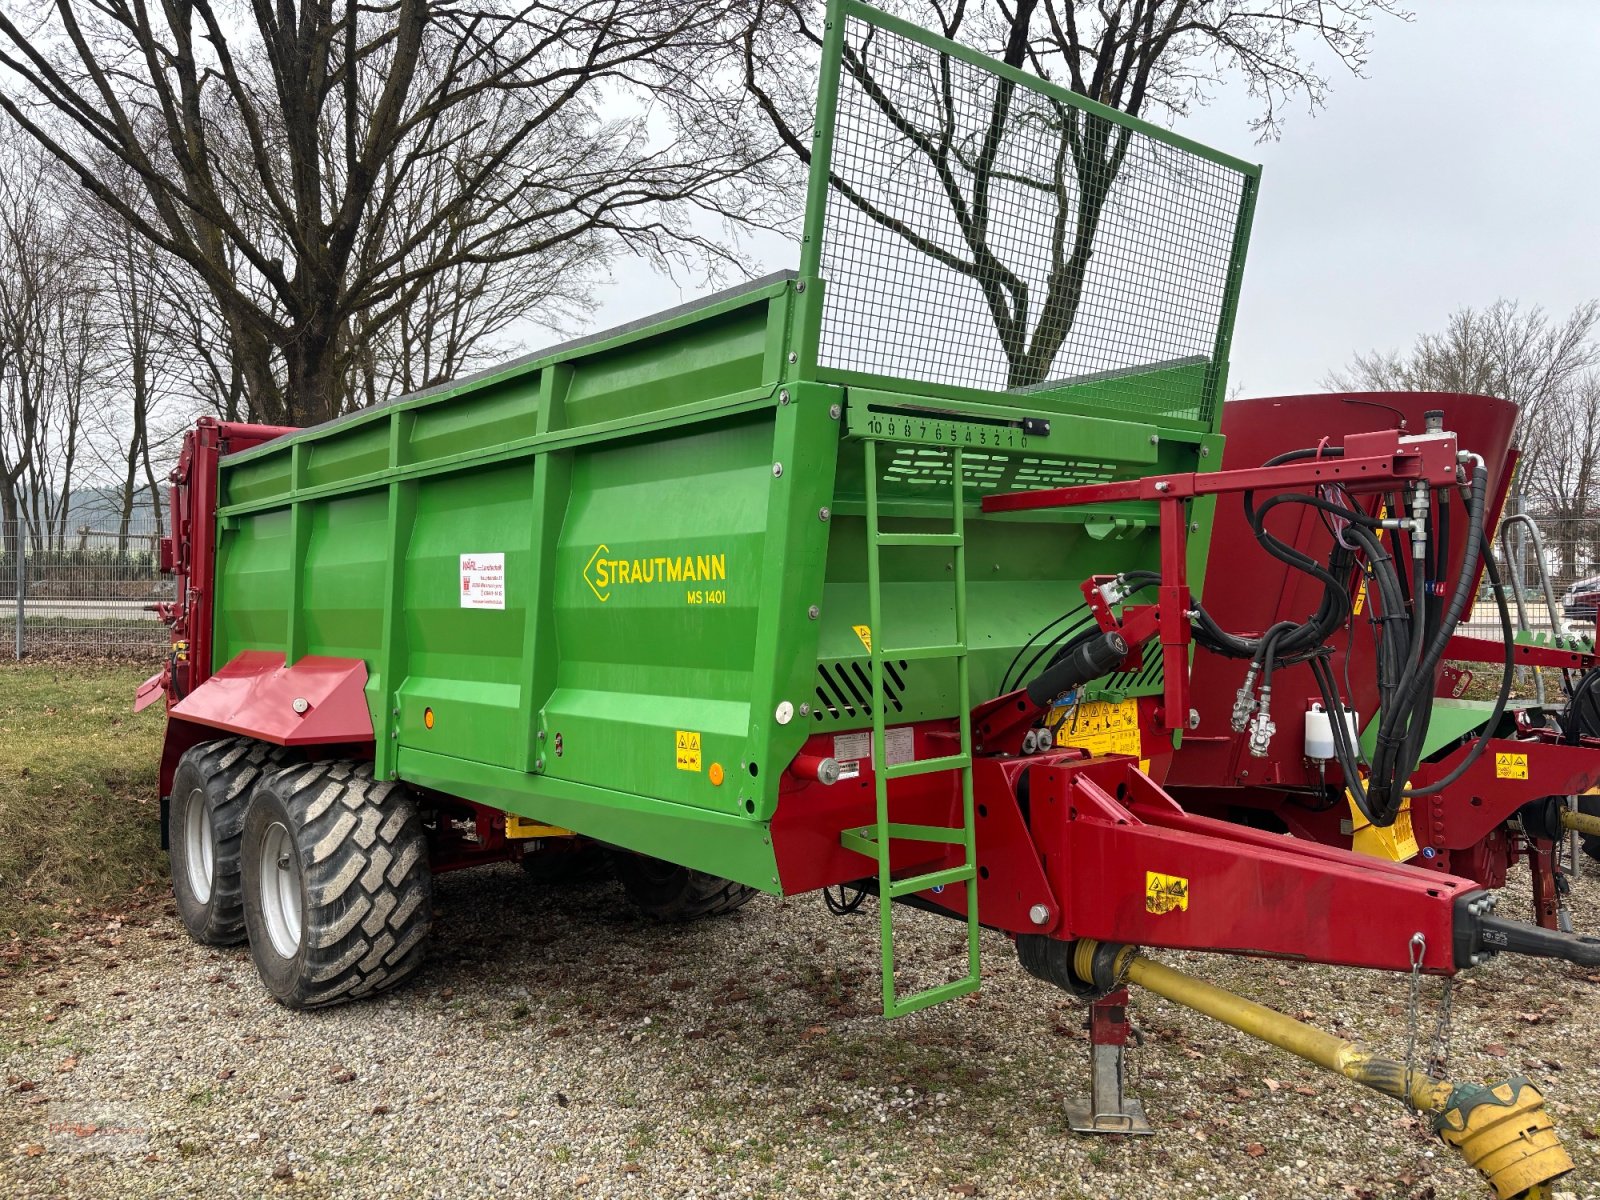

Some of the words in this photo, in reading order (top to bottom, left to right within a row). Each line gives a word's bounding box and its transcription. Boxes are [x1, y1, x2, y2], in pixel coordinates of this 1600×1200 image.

[867, 420, 882, 435] 10
[888, 422, 895, 436] 9
[904, 424, 911, 438] 8
[919, 426, 926, 439] 7
[935, 428, 942, 441] 6
[950, 430, 957, 442] 5
[965, 431, 972, 443] 4
[980, 433, 986, 445] 3
[994, 434, 1000, 447] 2
[1007, 435, 1013, 447] 1
[1021, 436, 1028, 448] 0
[595, 553, 726, 588] STRAUTMANN
[687, 590, 703, 605] MS
[705, 589, 726, 605] 1401
